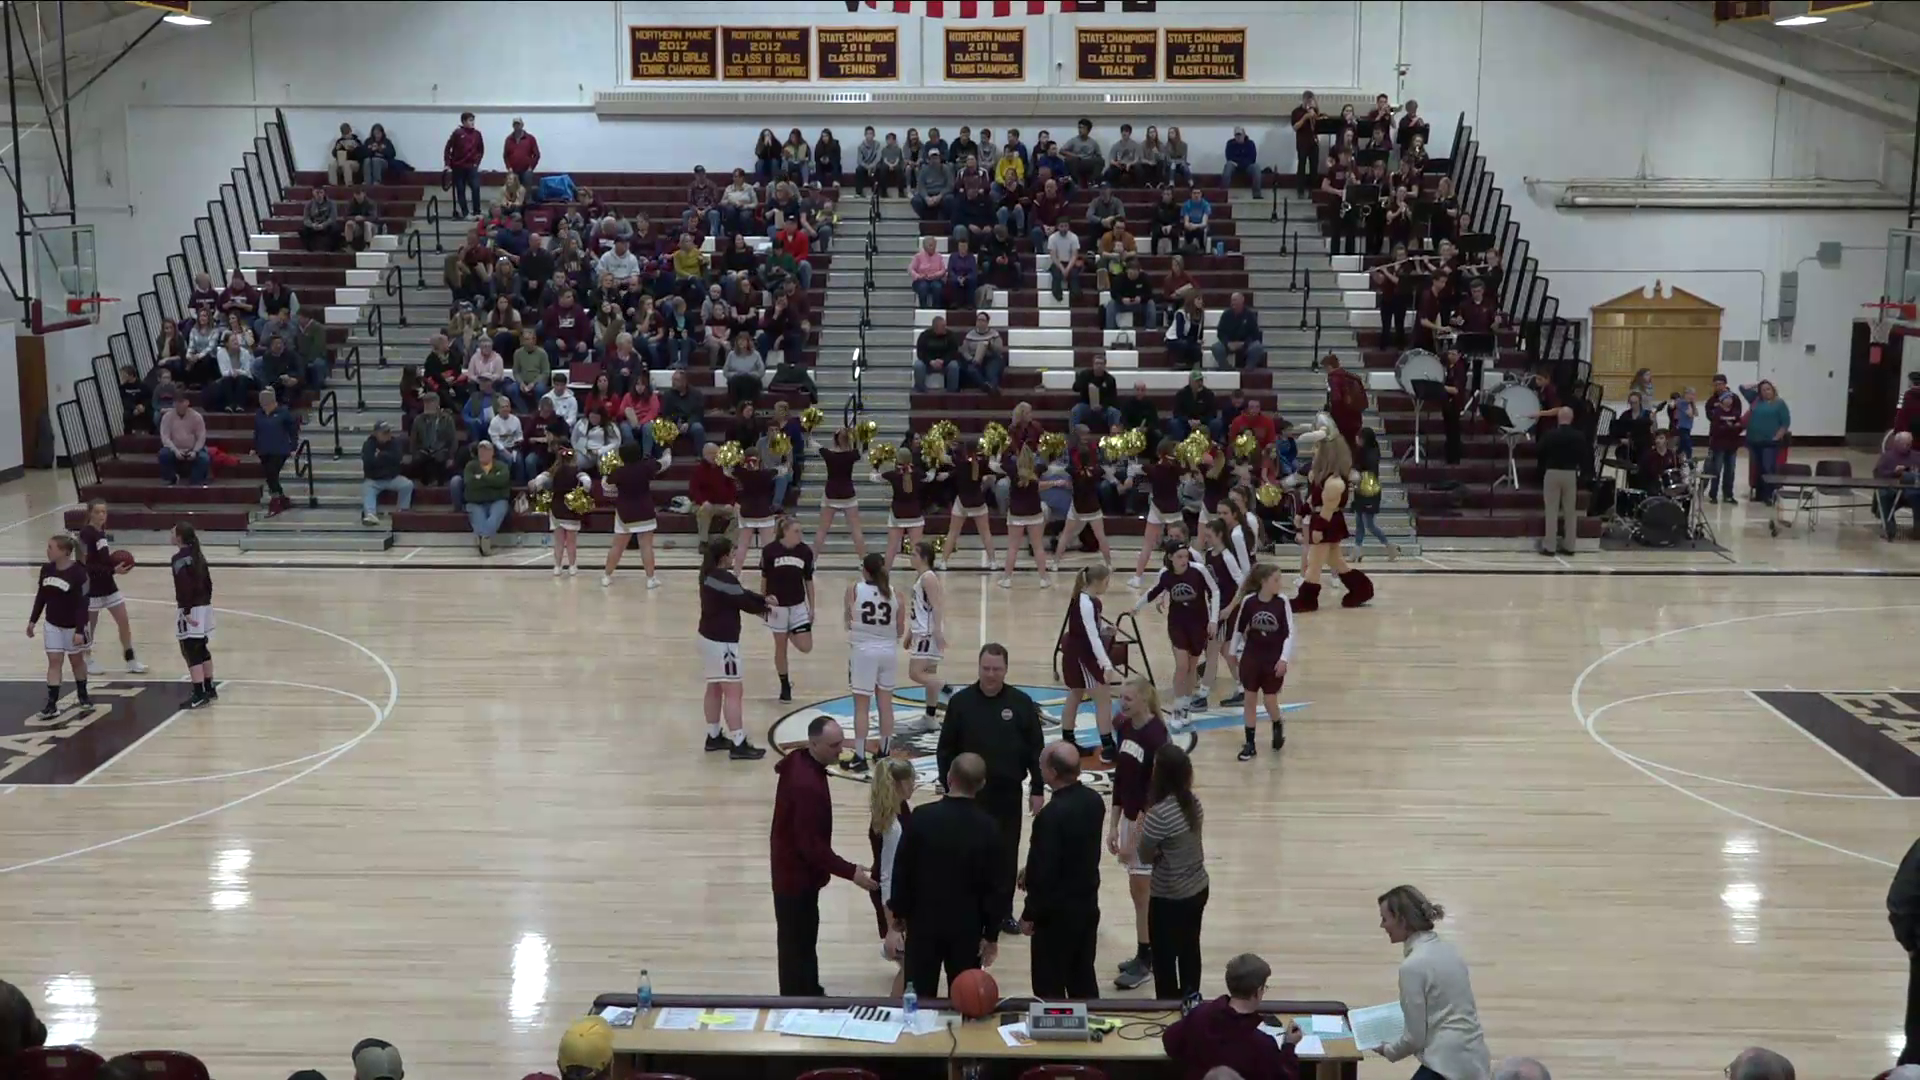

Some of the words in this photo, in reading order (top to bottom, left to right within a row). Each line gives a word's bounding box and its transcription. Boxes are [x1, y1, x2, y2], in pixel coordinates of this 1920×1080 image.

[635, 30, 682, 40] NORTHERN
[685, 30, 712, 40] MAINE
[731, 30, 772, 40] NORTHERN
[775, 30, 801, 40] MAINE
[819, 32, 845, 43] STATE
[846, 32, 895, 43] CHAMPIONS
[948, 31, 993, 42] NORTHERN
[994, 31, 1021, 42] MAINE
[1079, 33, 1105, 43] STATE
[1106, 33, 1155, 43] CHAMPIONS
[1167, 33, 1193, 43] STATE
[1194, 33, 1243, 43] CHAMPIONS
[659, 41, 689, 50] 2017
[750, 42, 782, 51] 2017
[640, 52, 669, 63] CLASS
[682, 52, 708, 63] GIRLS
[732, 53, 762, 64] CLASS
[774, 53, 801, 64] GIRLS
[828, 53, 855, 63] CLASS
[864, 53, 887, 63] BOYS
[954, 53, 981, 62] CLASS
[991, 53, 1014, 62] GIRLS
[1087, 54, 1115, 63] CLASS
[1124, 54, 1147, 63] BOYS
[1175, 54, 1202, 63] CLASS
[1211, 54, 1234, 63] BOYS
[638, 64, 665, 75] TENNIS
[668, 64, 711, 75] CHAMPIONS
[839, 64, 876, 75] TENNIS
[950, 64, 976, 74] TENNIS
[976, 64, 1019, 74] CHAMPIONS
[1099, 65, 1134, 76] TRACK
[1173, 65, 1237, 76] BASKETBALL
[861, 601, 892, 625] 23
